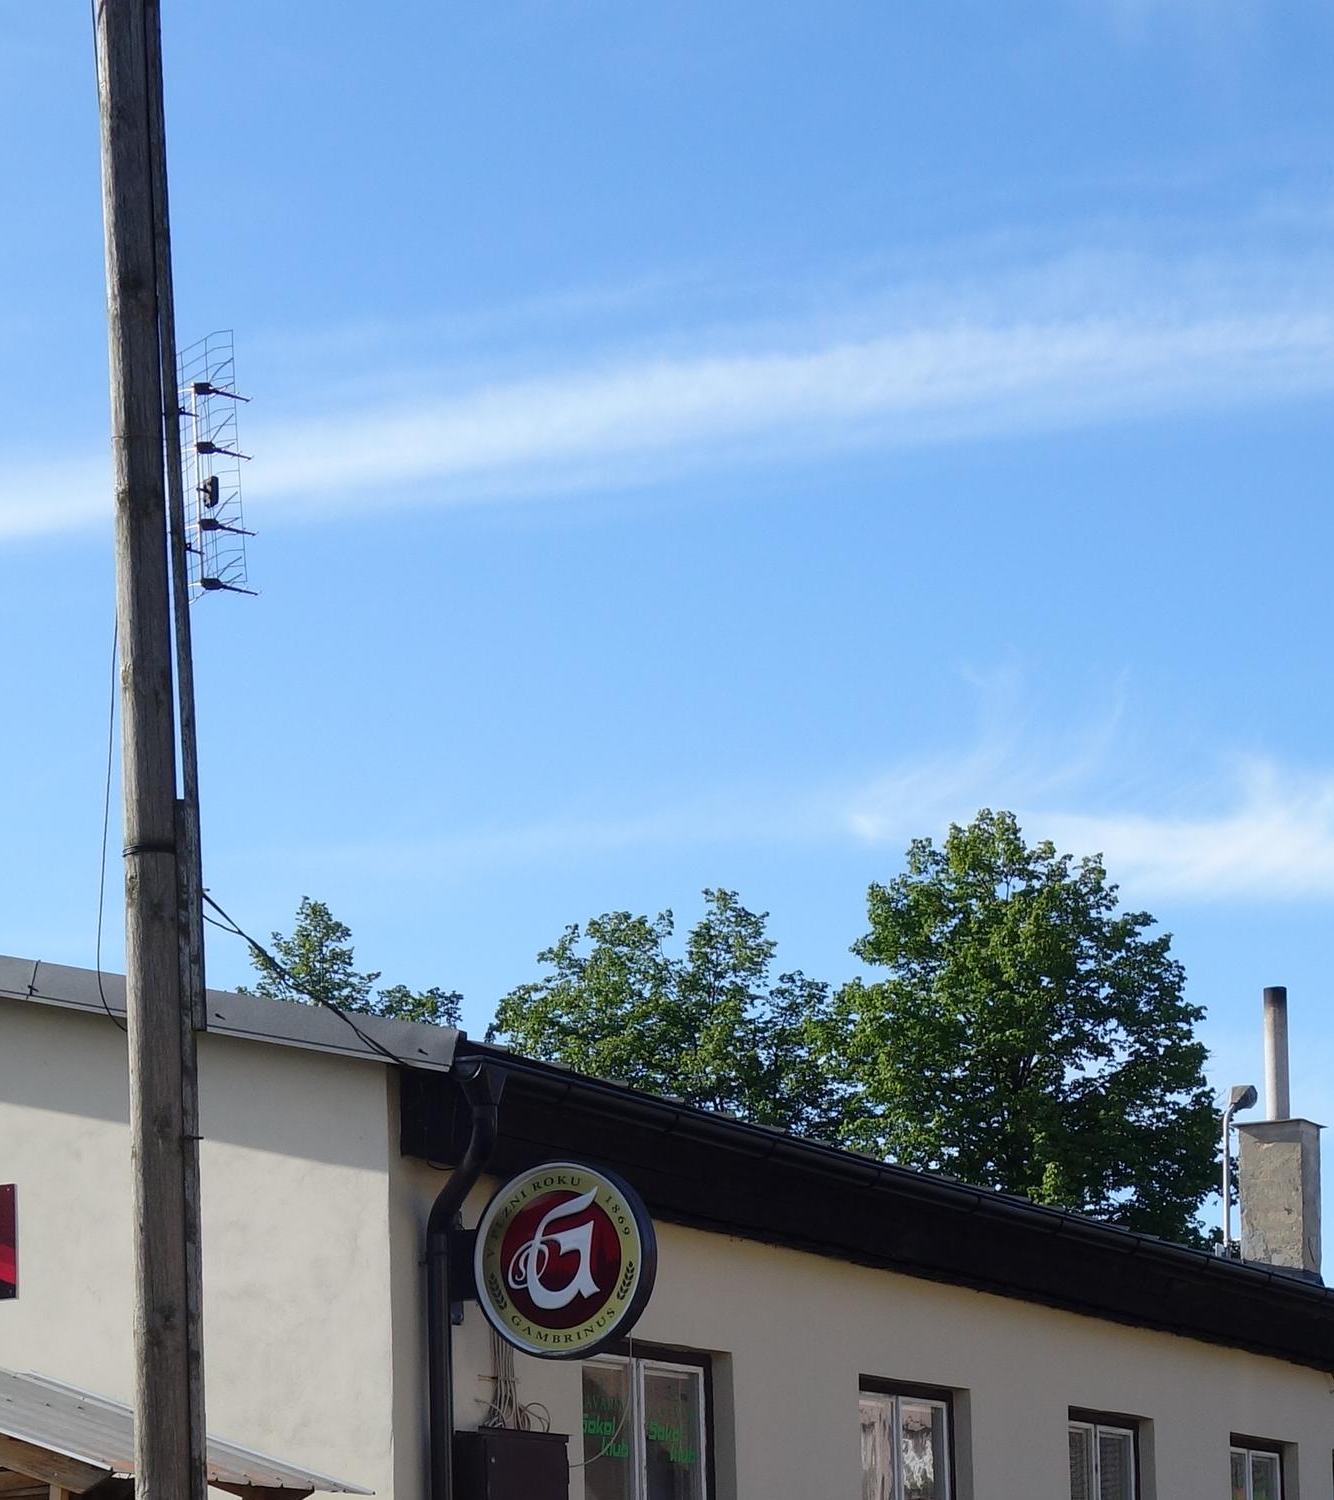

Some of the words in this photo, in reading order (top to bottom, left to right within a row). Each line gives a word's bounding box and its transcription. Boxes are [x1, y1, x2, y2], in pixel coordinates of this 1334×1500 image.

[531, 1175, 582, 1192] ROKU
[604, 1195, 631, 1236] 1869
[510, 1307, 617, 1344] GAMBRINUS
[648, 1420, 684, 1441] Sokol
